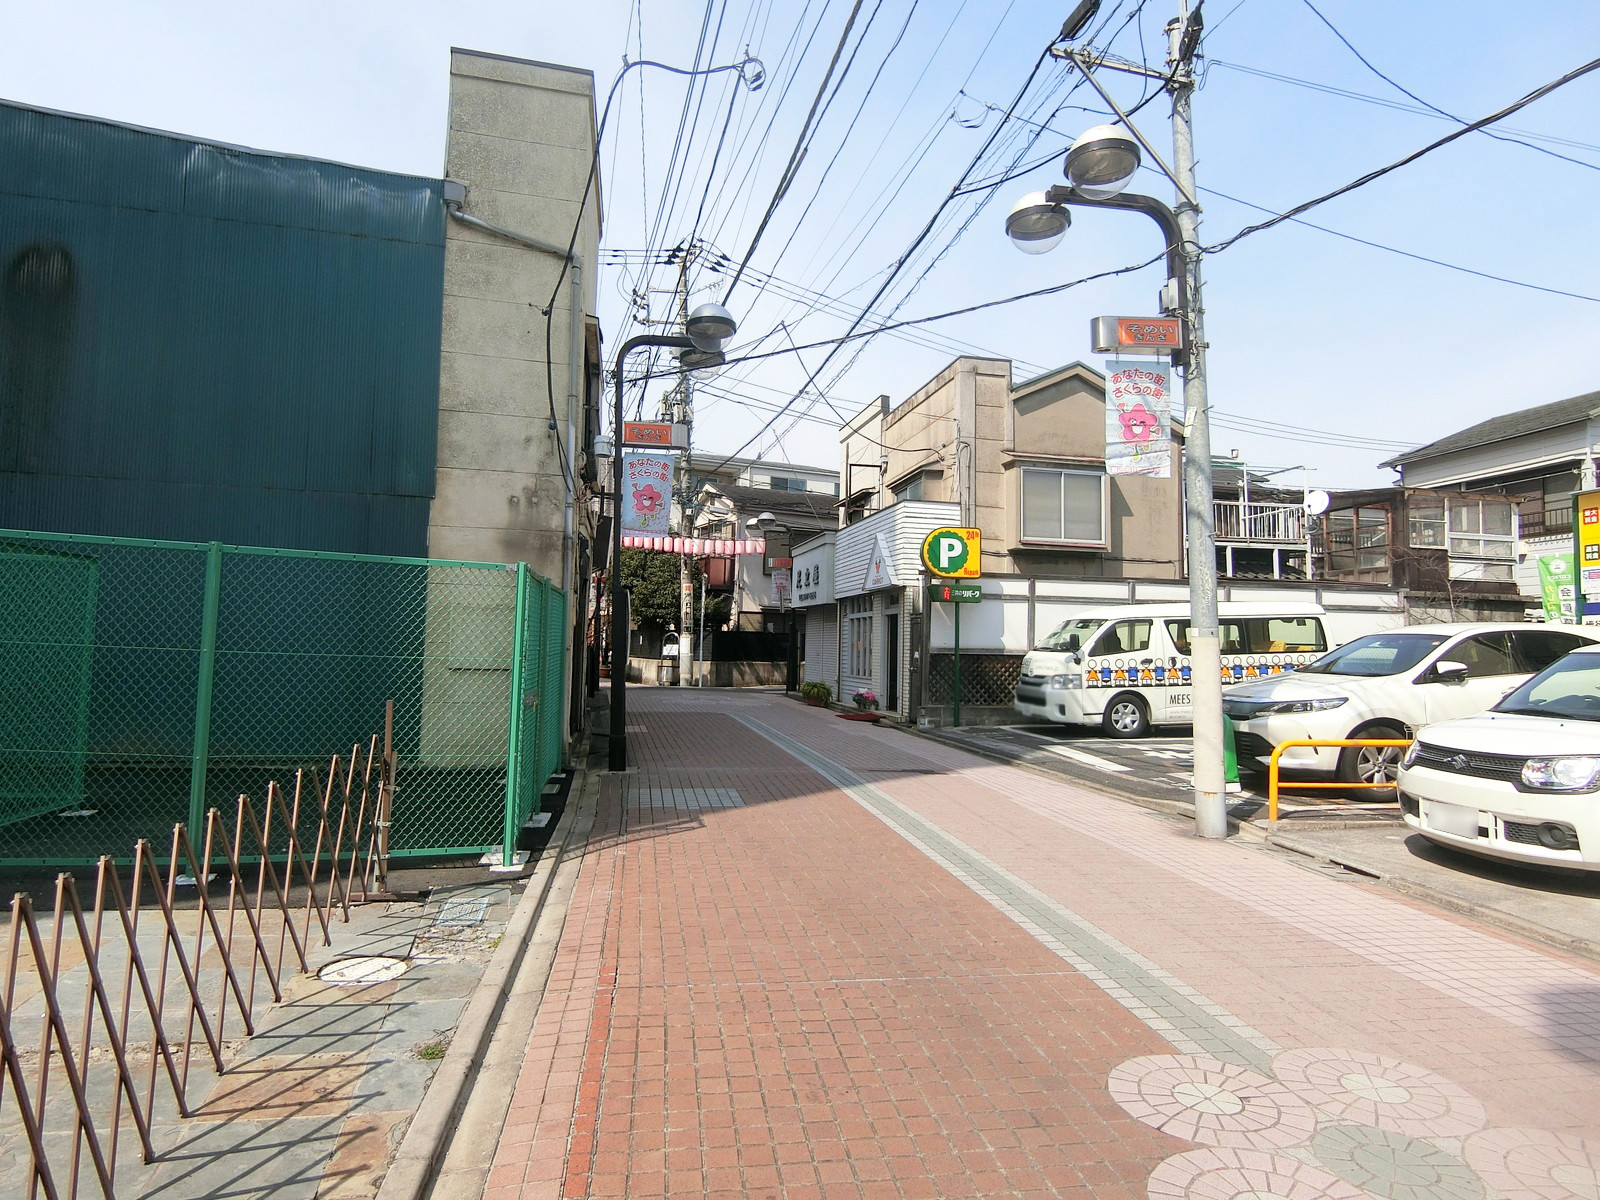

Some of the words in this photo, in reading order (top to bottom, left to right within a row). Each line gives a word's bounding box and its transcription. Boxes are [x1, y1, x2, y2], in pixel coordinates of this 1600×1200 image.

[1127, 323, 1174, 334] そめい
[1135, 333, 1167, 342] ぎんざ
[1110, 368, 1166, 387] あなたの街
[1112, 383, 1165, 400] さくらの街
[631, 427, 668, 435] そめい
[628, 458, 671, 472] あなたの街
[628, 468, 669, 482] さくらの街
[939, 537, 963, 568] P
[963, 567, 979, 576] Repark
[1169, 693, 1191, 705] MEES
